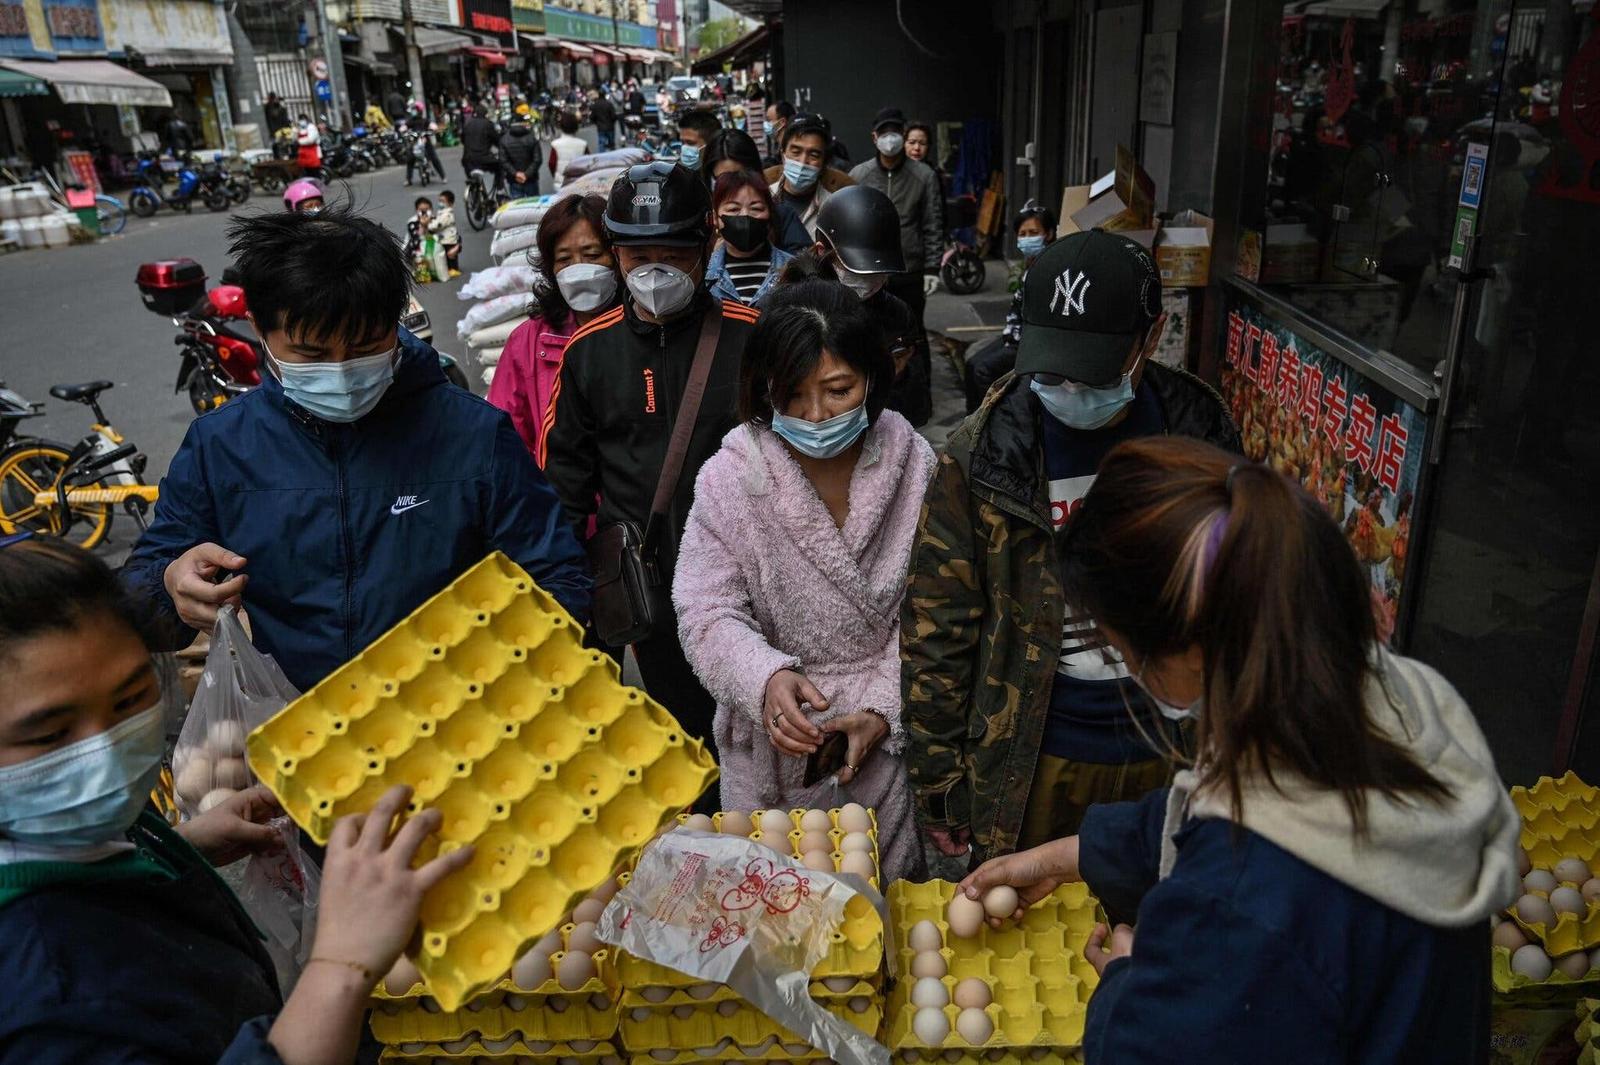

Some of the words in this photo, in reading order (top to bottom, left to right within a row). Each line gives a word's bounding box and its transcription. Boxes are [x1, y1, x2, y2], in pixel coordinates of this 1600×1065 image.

[1049, 268, 1091, 316] NY
[1225, 310, 1408, 497] 南汇散养鸡专卖店
[395, 495, 418, 506] NIKE
